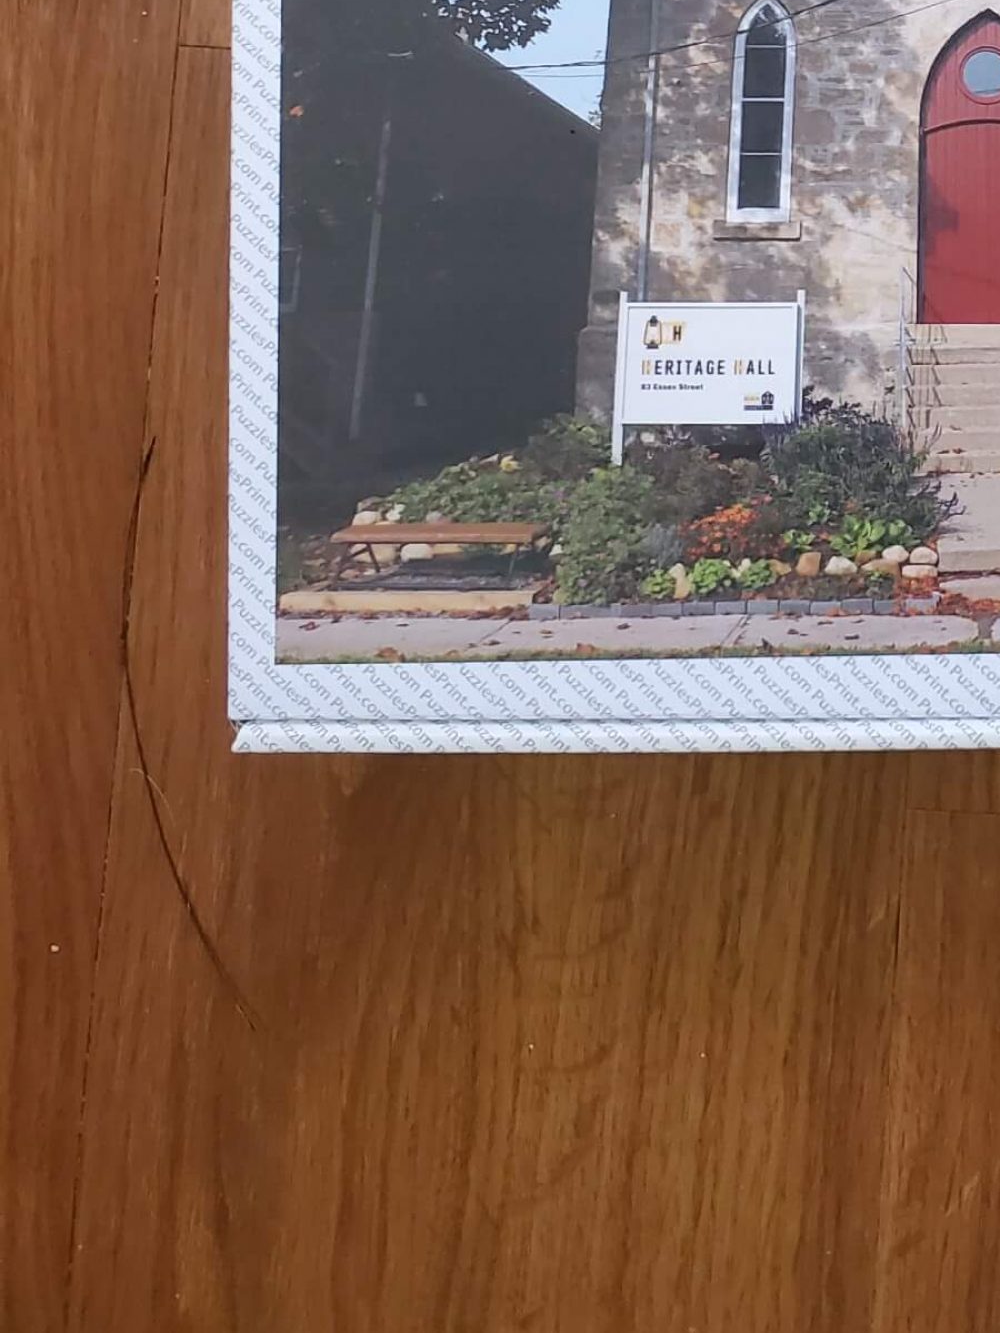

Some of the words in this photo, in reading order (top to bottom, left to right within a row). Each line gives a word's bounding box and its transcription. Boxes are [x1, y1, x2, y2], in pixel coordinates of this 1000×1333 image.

[673, 325, 682, 341] H
[641, 359, 726, 375] HERITAGE
[734, 359, 775, 375] HALL
[679, 383, 703, 391] Street
